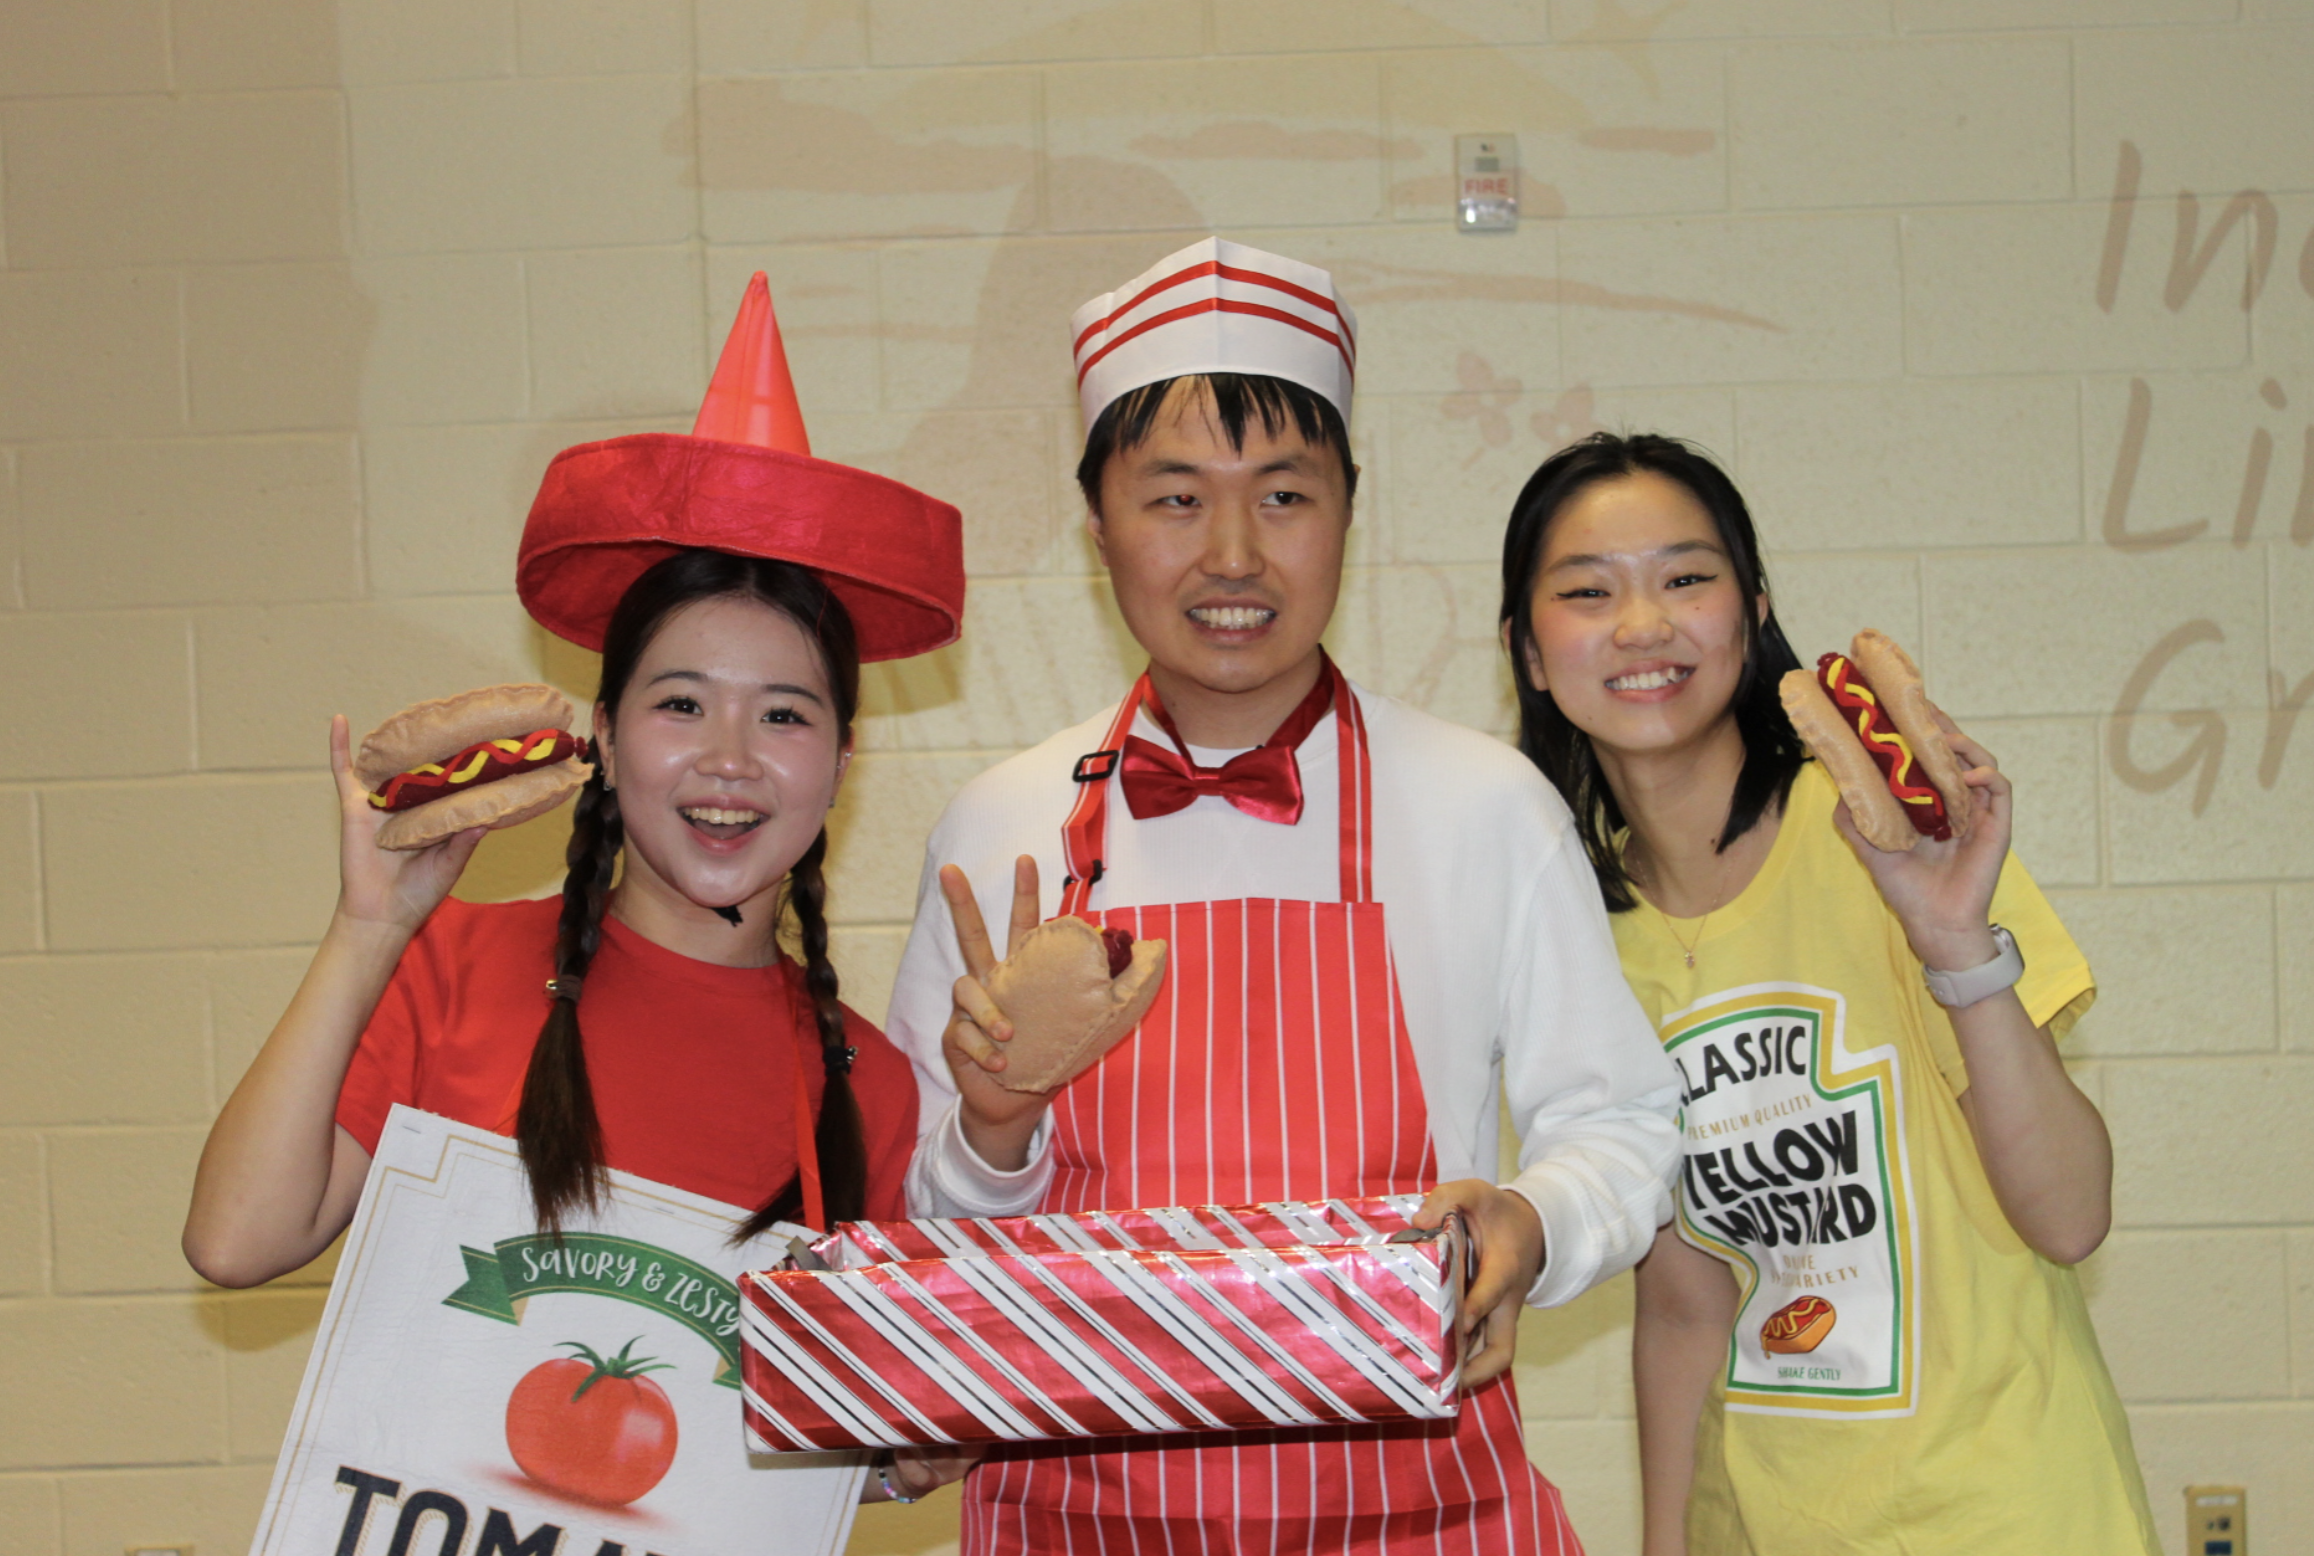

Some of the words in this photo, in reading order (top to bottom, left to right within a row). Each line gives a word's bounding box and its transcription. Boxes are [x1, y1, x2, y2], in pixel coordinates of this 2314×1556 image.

[1464, 178, 1509, 196] FIRE
[2095, 139, 2314, 314] In
[1675, 1025, 1806, 1107] LASSIC
[1754, 1094, 1813, 1126] QUALITY
[641, 1262, 667, 1293] &
[1787, 1266, 1858, 1289] ARIETY
[1808, 1367, 1842, 1381] GENTLY
